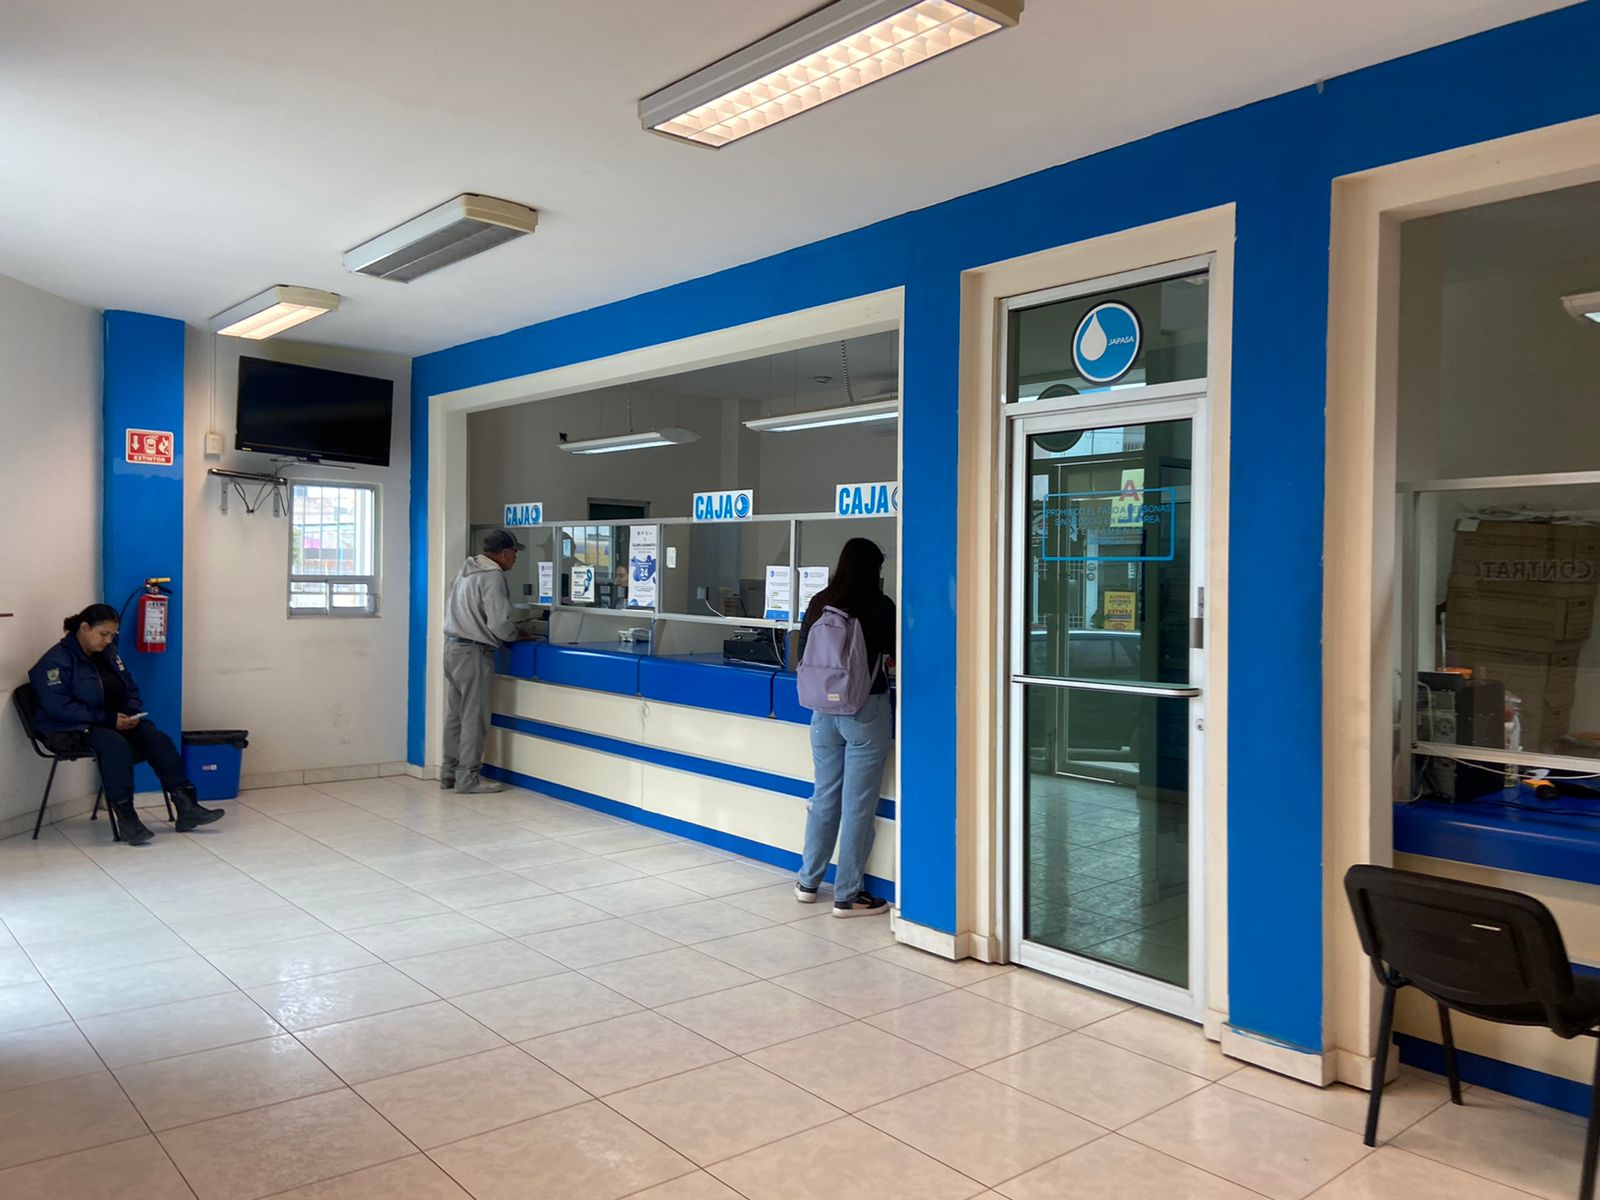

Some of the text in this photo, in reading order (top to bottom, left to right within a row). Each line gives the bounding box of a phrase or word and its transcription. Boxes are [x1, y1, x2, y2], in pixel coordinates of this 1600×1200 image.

[1108, 336, 1134, 346] JAPASA
[695, 494, 733, 519] CAJA
[839, 485, 889, 515] CAJA
[506, 506, 530, 526] CAJA
[1098, 506, 1119, 515] PAO
[1129, 504, 1171, 514] ERSONAS
[640, 568, 648, 577] 24
